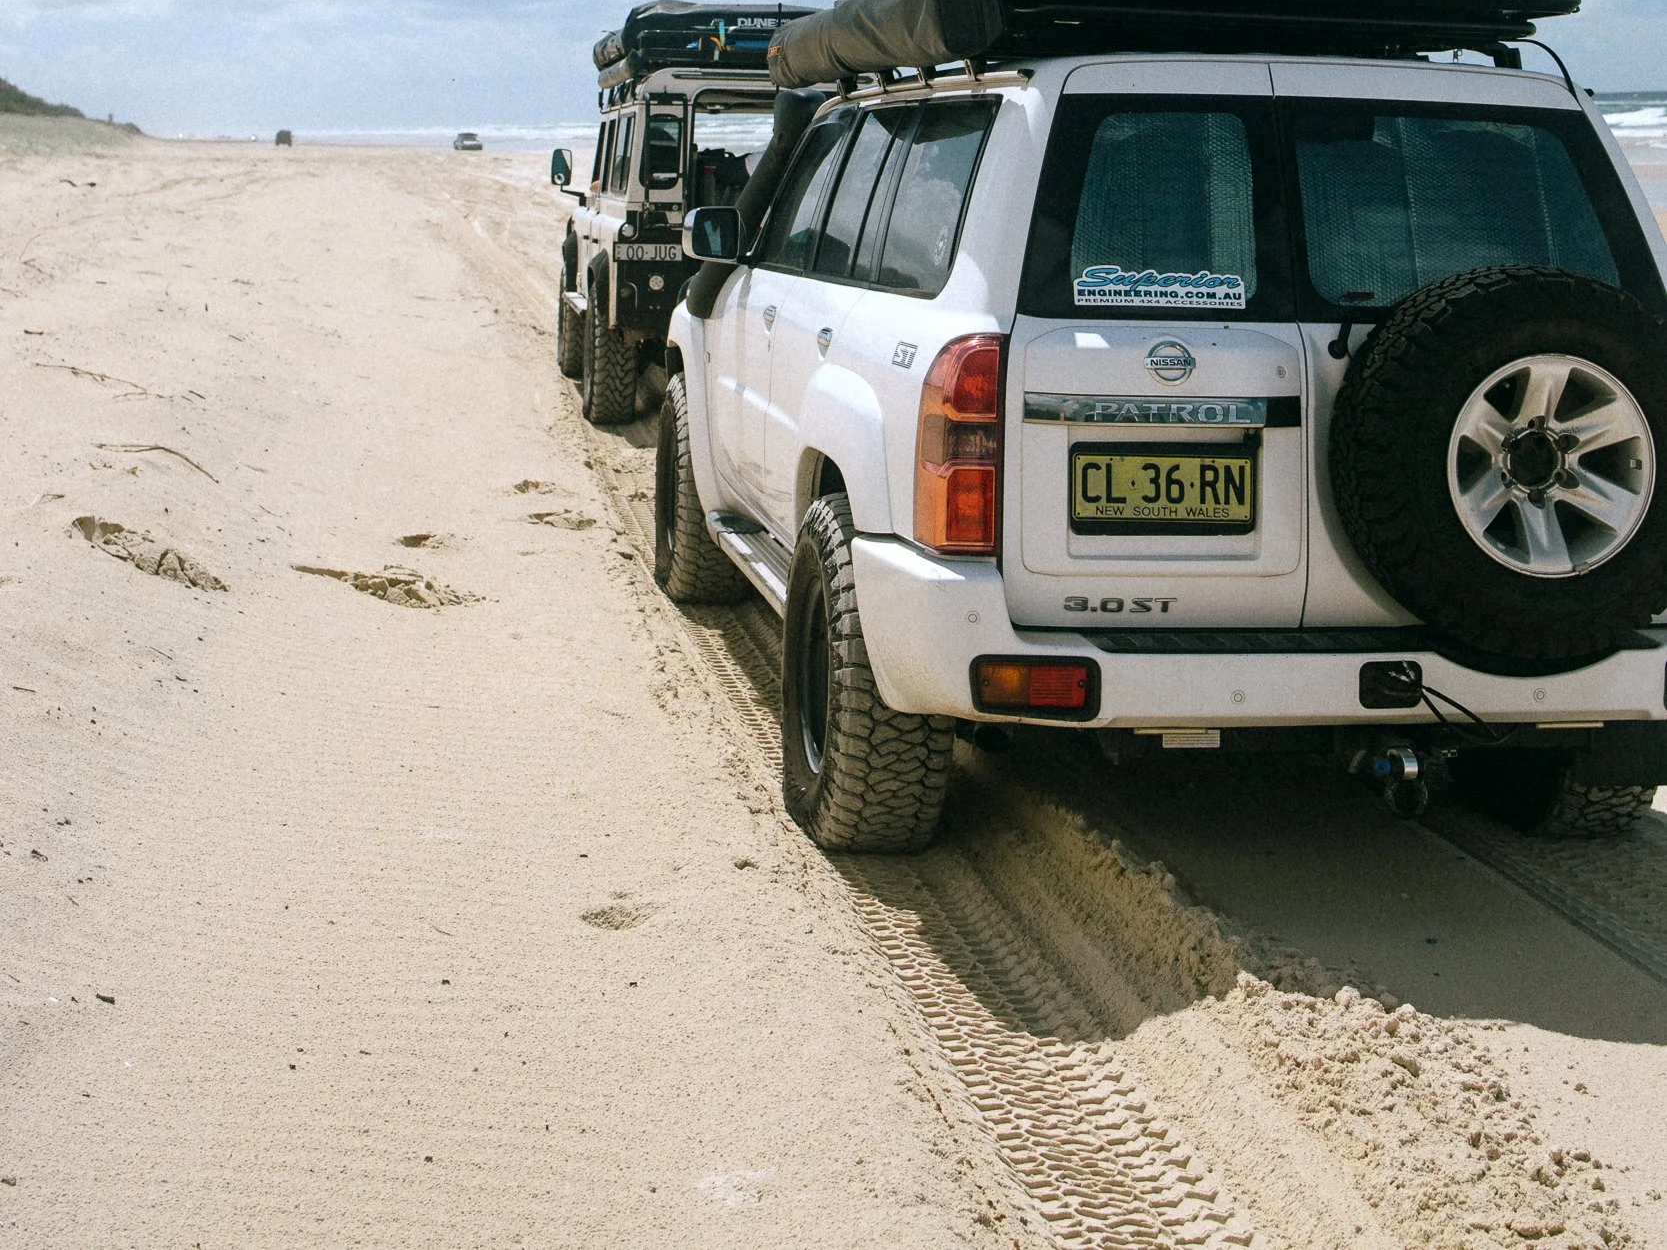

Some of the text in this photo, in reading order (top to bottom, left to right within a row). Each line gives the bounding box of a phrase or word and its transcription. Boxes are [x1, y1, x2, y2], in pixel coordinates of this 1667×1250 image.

[737, 17, 776, 28] DUNE
[1077, 267, 1241, 291] Superior
[1077, 289, 1242, 301] ENGINEERING.COM.AU
[1150, 358, 1191, 367] NISSAN
[1094, 402, 1251, 423] PATROL
[1095, 505, 1230, 519] NEW SOUTH WALES
